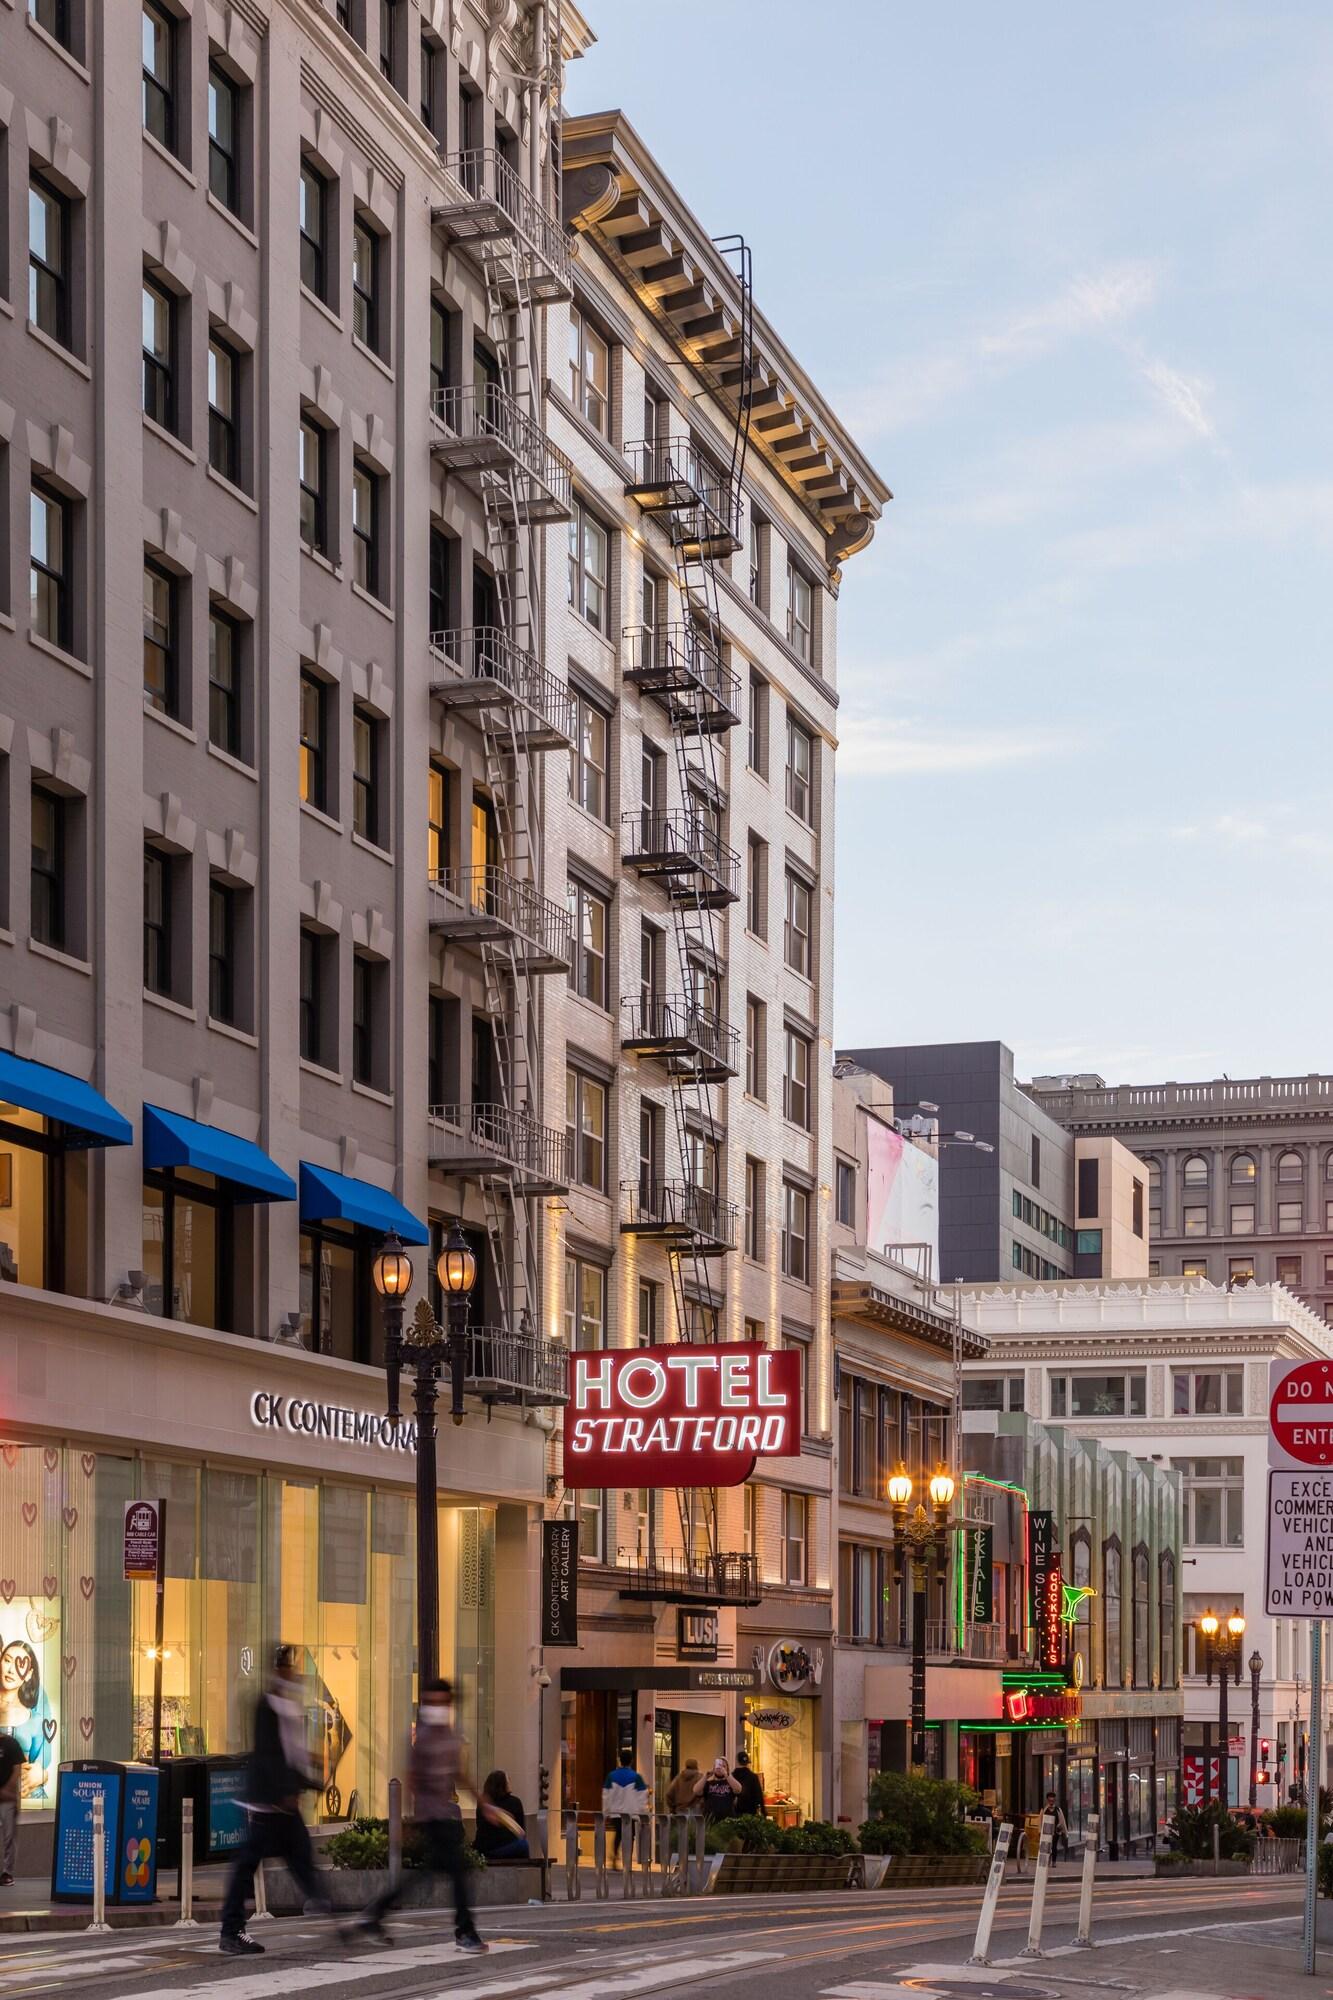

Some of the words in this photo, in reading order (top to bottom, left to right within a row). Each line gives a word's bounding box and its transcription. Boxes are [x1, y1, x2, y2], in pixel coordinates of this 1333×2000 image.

[575, 1354, 787, 1409] HOTEL
[1287, 1381, 1312, 1398] DO
[254, 1393, 283, 1427] CK
[288, 1400, 438, 1452] CONTEMPORA
[572, 1415, 786, 1452] STRATFORD
[561, 1527, 570, 1576] GALLERY
[1033, 1518, 1047, 1566] WINE
[551, 1527, 560, 1618] CONTEMPORARY
[560, 1579, 569, 1601] ART
[1271, 1589, 1293, 1605] ON
[551, 1621, 560, 1637] CK
[1049, 1572, 1058, 1664] COCKTAILS
[72, 1788, 107, 1799] SQUARE
[78, 1781, 102, 1789] UNION
